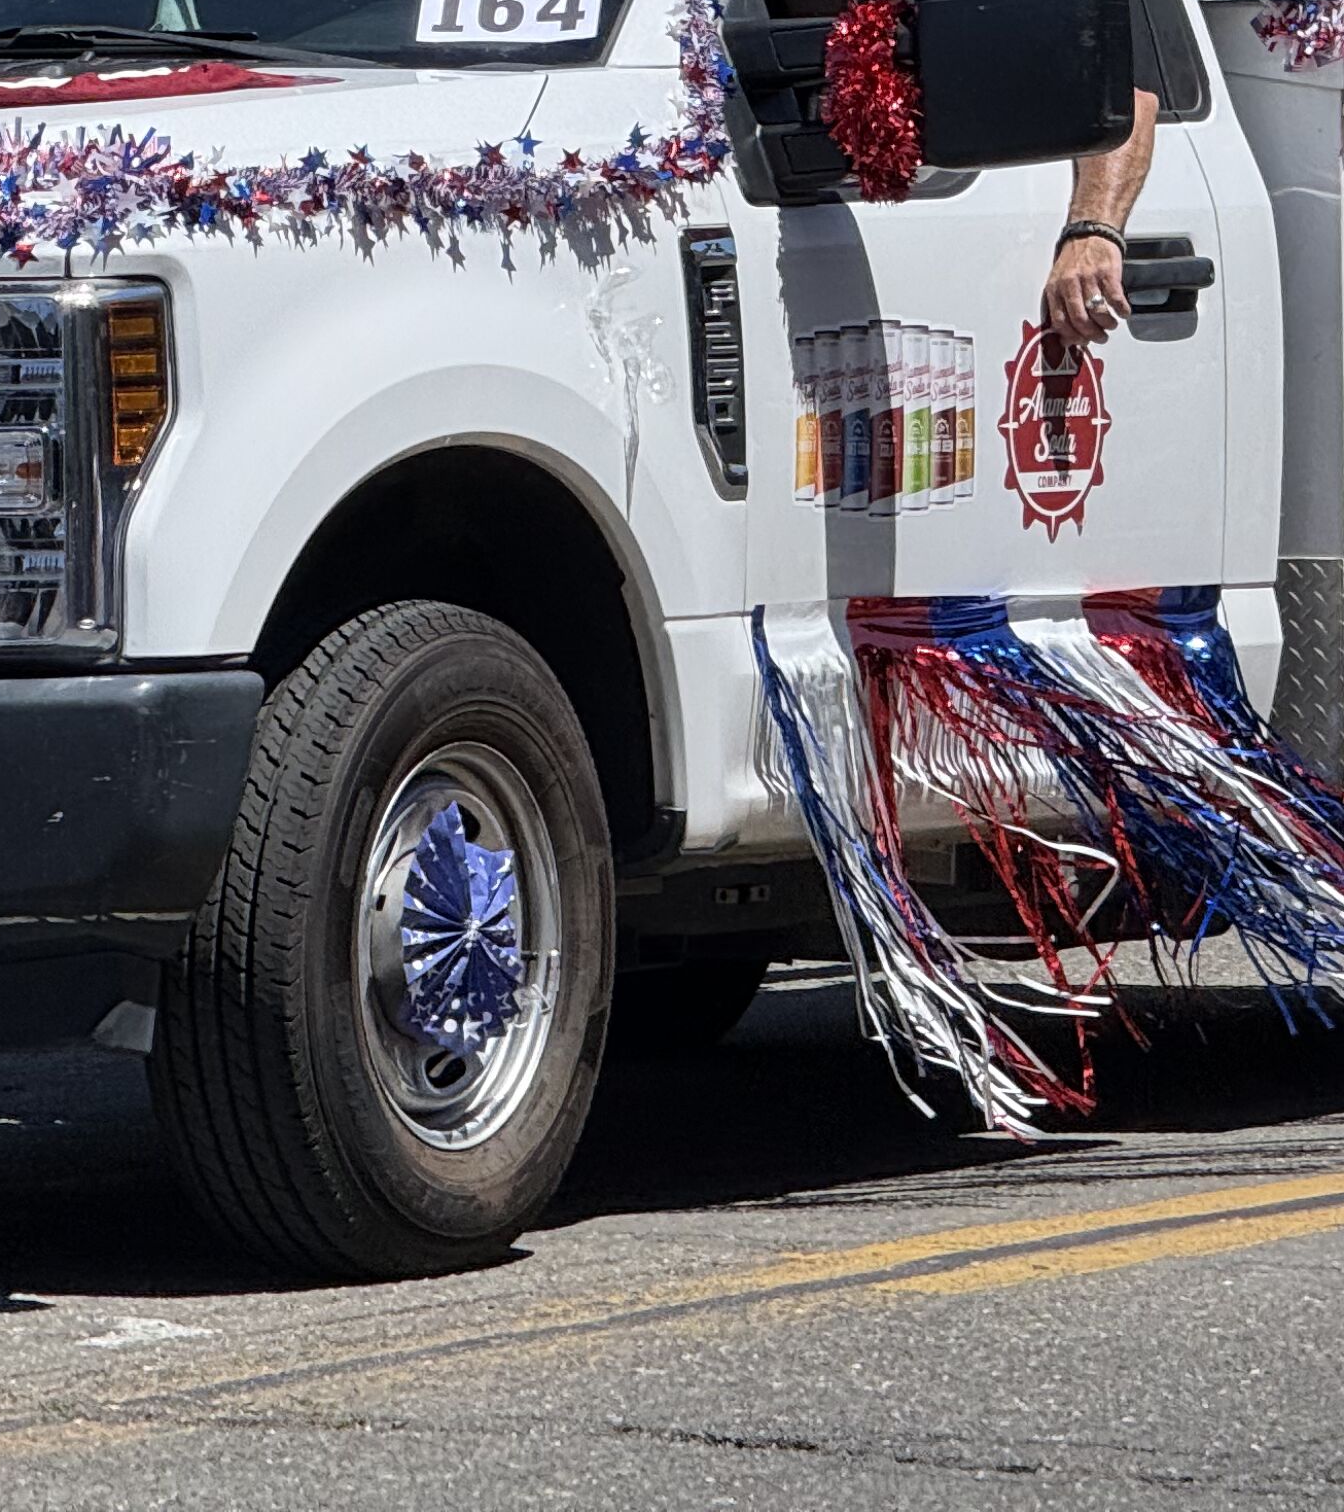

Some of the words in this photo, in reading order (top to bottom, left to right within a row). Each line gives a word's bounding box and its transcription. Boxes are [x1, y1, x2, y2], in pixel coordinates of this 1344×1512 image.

[1019, 382, 1091, 425] Alameda
[1034, 420, 1078, 463] Soda
[1037, 474, 1073, 489] COMPANY
